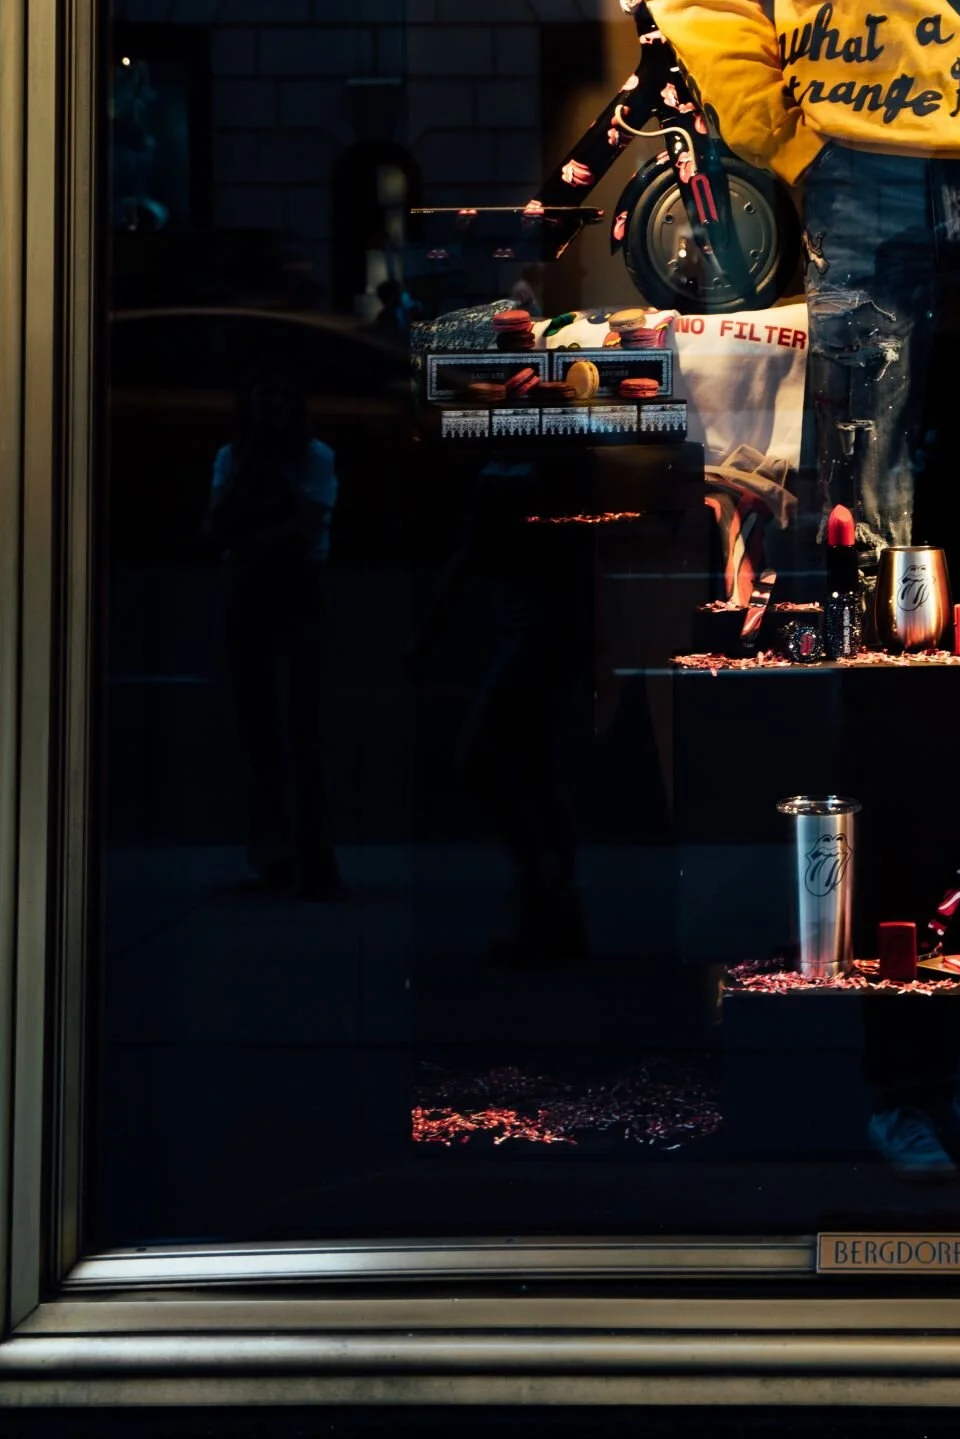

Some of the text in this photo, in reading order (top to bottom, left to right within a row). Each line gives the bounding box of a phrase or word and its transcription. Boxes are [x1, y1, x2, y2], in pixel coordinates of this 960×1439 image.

[916, 14, 955, 46] a
[675, 318, 807, 349] NO FILTER
